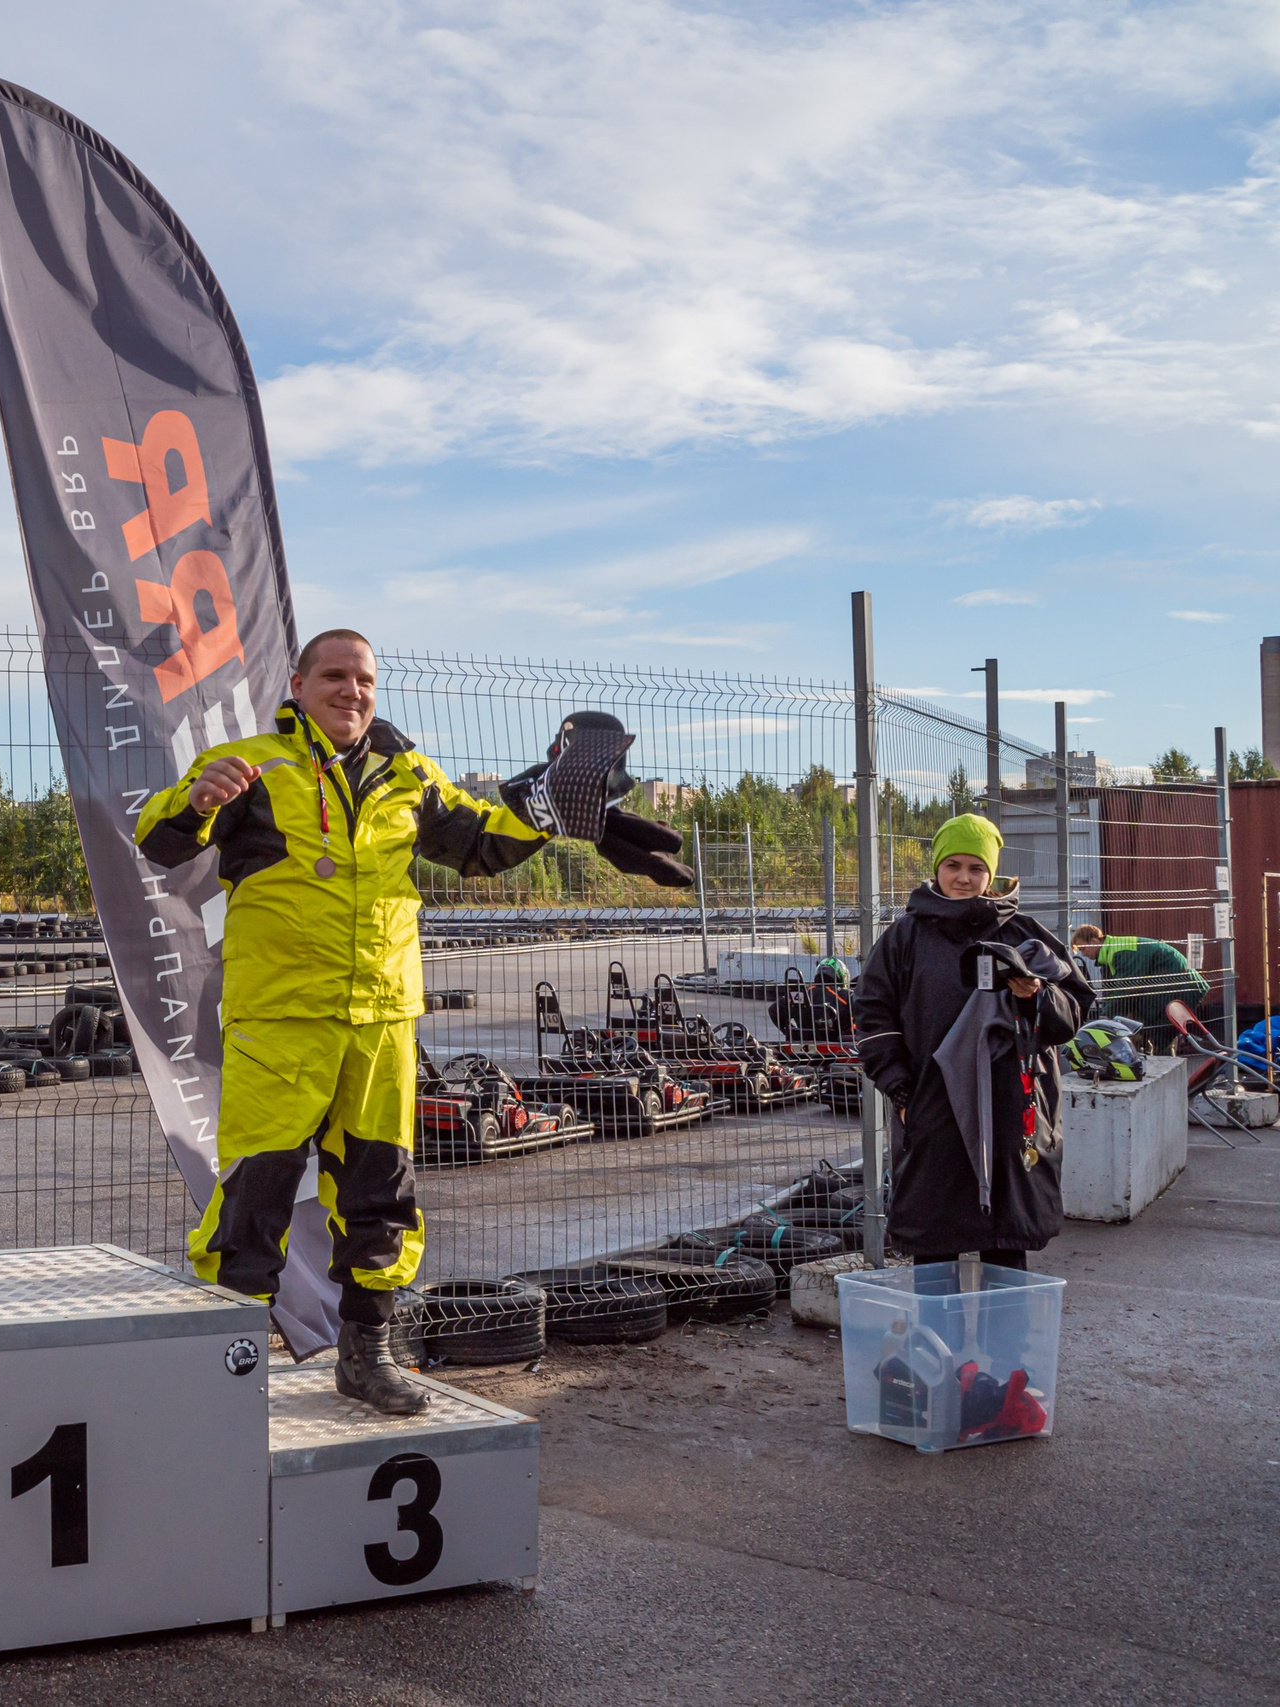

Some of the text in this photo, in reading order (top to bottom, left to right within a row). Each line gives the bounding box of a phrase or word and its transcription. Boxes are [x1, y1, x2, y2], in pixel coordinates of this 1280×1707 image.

[663, 1003, 676, 1013] 27
[546, 1014, 560, 1025] 10
[237, 1356, 258, 1366] BRP
[10, 1423, 90, 1569] 1
[363, 1452, 444, 1586] 3
